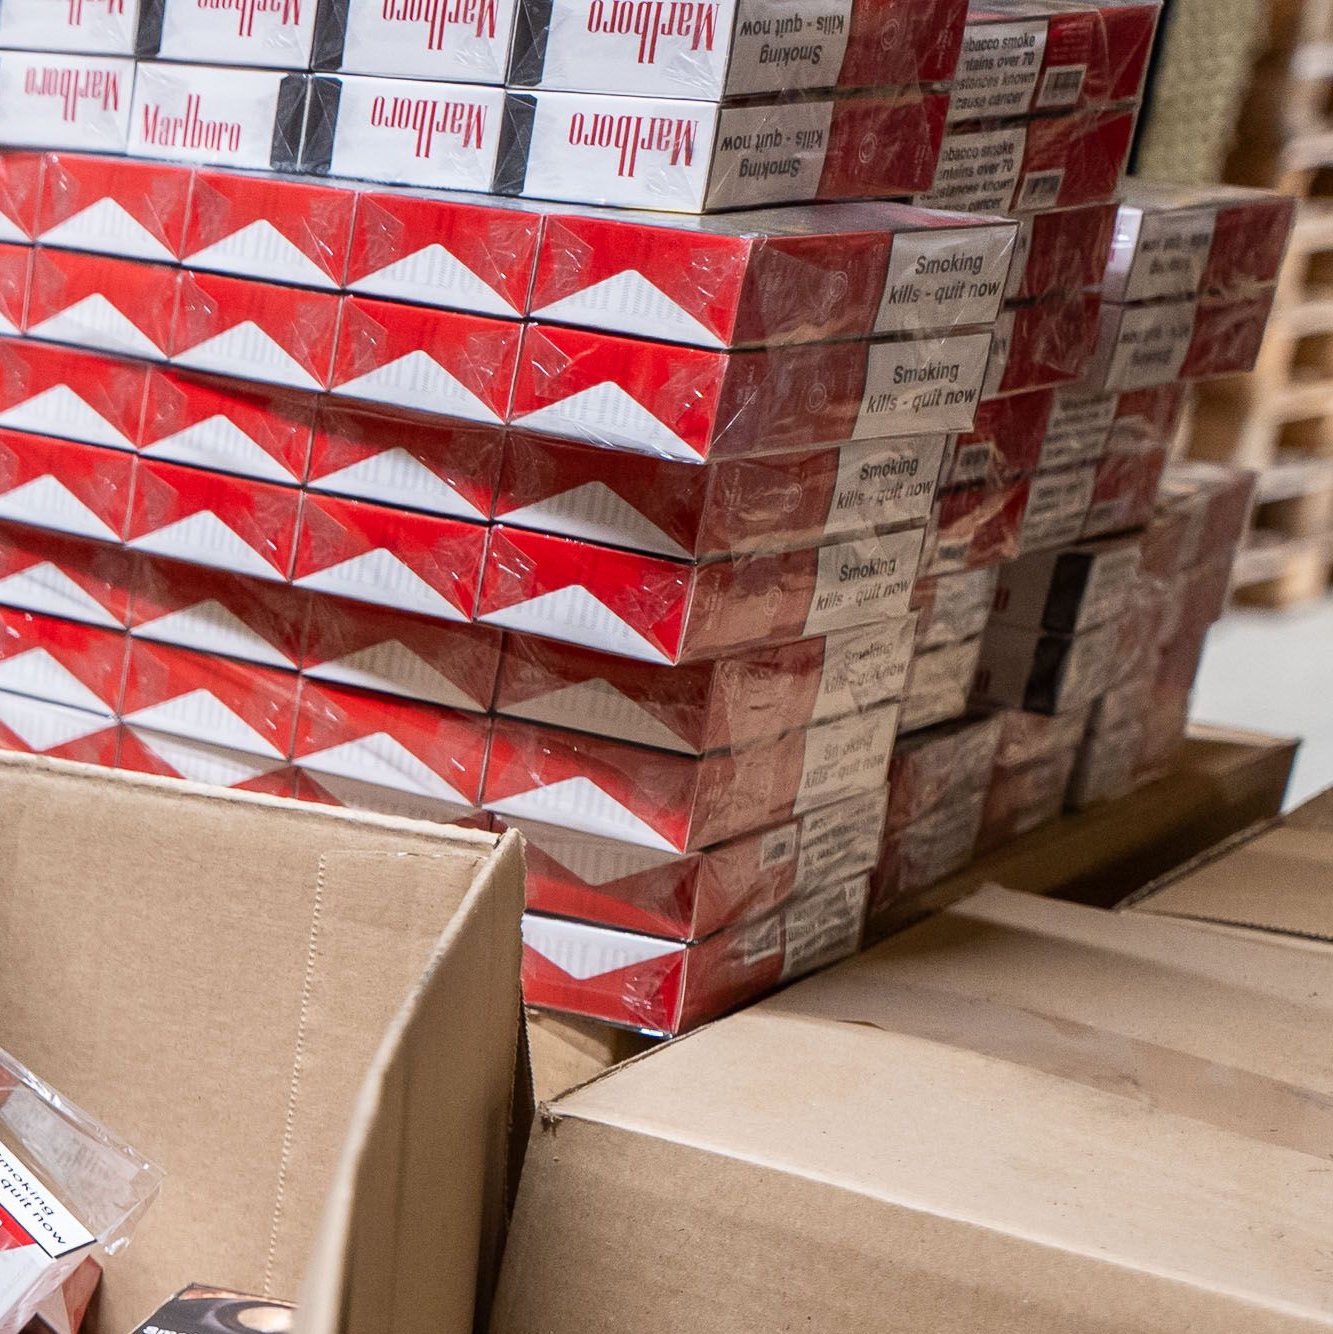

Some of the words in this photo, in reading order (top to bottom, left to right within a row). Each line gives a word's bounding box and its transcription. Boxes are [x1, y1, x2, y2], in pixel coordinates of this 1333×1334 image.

[588, 0, 720, 63] Marlboro
[740, 19, 771, 36] now
[774, 17, 803, 36] quit
[817, 14, 844, 33] kills
[1002, 33, 1035, 49] smoke
[760, 44, 822, 64] Smoking
[997, 54, 1021, 68] over
[1023, 52, 1034, 66] 70
[25, 67, 119, 122] Marlboro
[143, 94, 241, 153] Marlboro
[371, 95, 488, 158] Marlboro
[569, 112, 699, 177] Marlboro
[721, 135, 753, 152] now
[755, 132, 781, 151] quit
[796, 129, 823, 147] kills
[739, 158, 801, 178] Smoking
[915, 253, 983, 276] Smoking
[888, 284, 920, 305] kills
[935, 282, 965, 304] quit
[968, 280, 1001, 298] now
[892, 362, 959, 385] Smoking
[867, 394, 898, 413] kills
[911, 392, 942, 414] quit
[945, 389, 976, 406] now
[860, 456, 918, 480] Smoking
[837, 489, 866, 510] kills
[876, 485, 901, 506] quit
[903, 480, 932, 498] now
[839, 558, 896, 584] Smoking
[816, 588, 843, 613] kills
[854, 584, 879, 609] quit
[882, 579, 910, 600] now
[0, 1178, 31, 1219] quit
[35, 1218, 66, 1244] now
